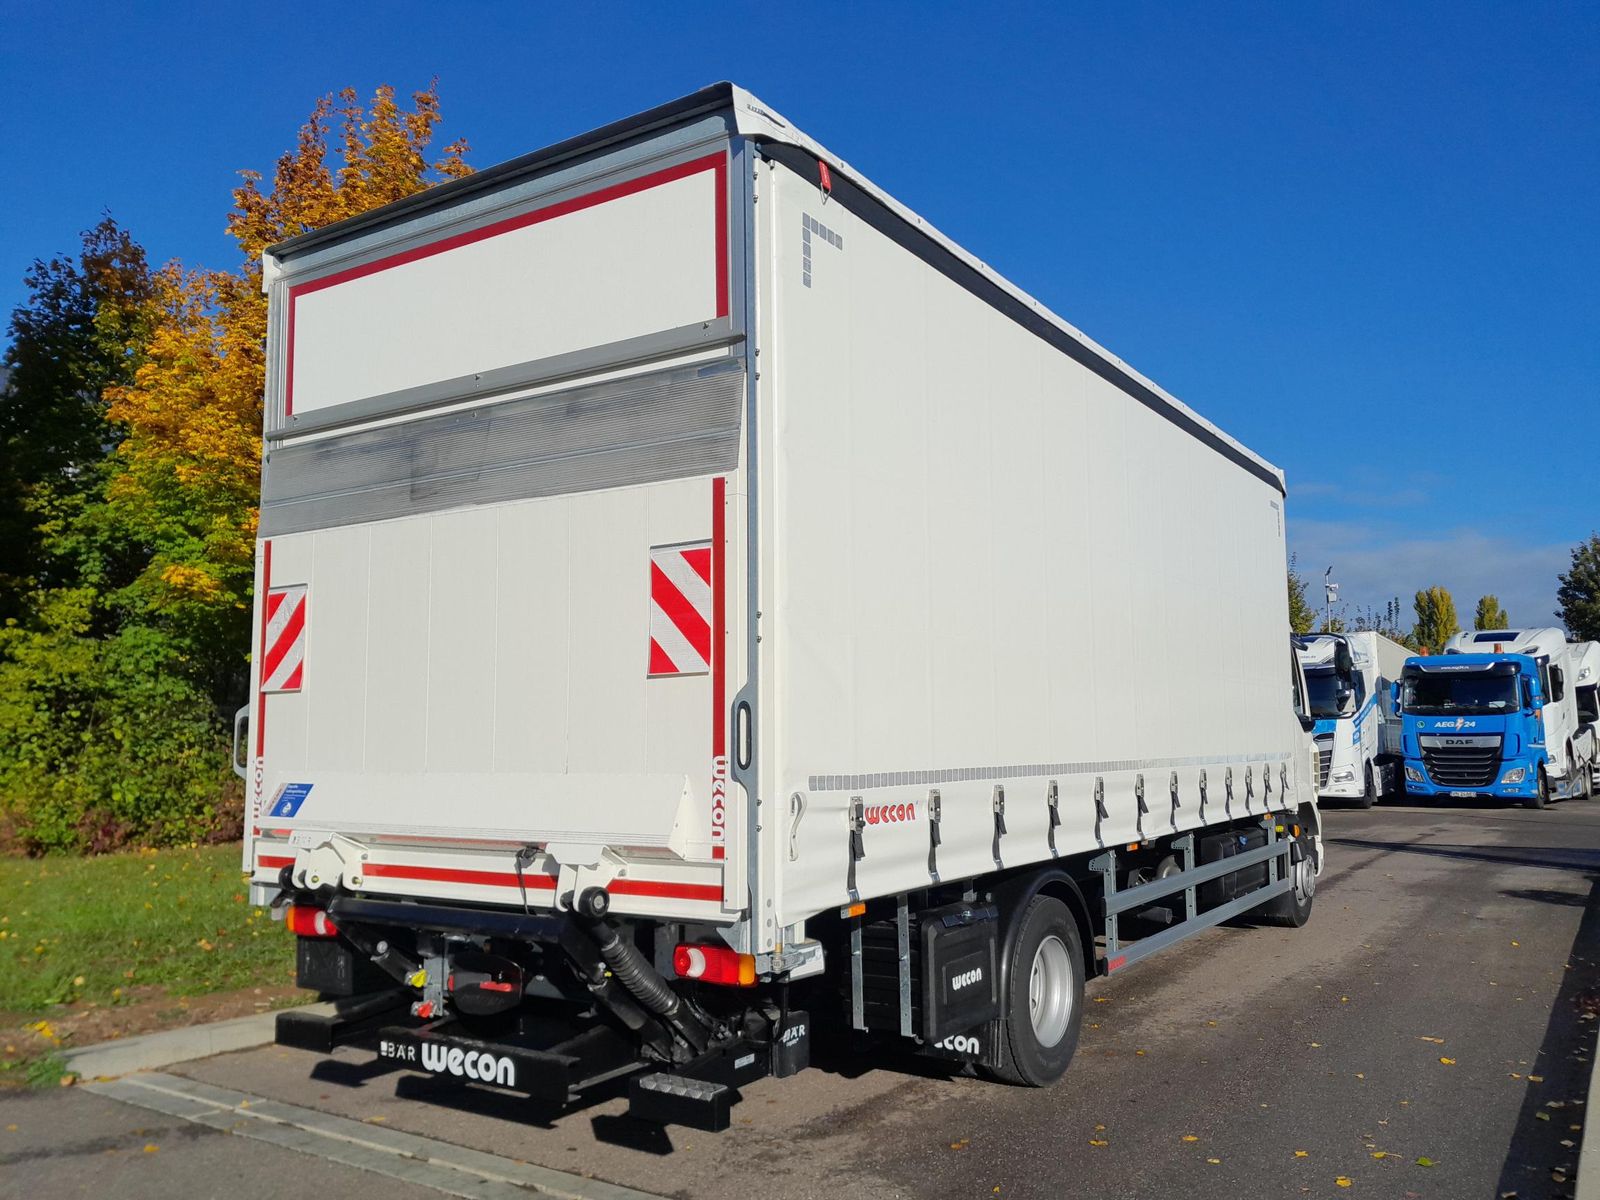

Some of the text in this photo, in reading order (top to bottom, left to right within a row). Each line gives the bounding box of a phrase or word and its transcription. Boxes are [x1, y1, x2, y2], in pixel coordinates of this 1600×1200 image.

[254, 757, 264, 823] wecon
[712, 755, 725, 841] wecon
[865, 803, 916, 825] wecon
[952, 967, 982, 991] wecon
[388, 1042, 515, 1087] BÄR wecon
